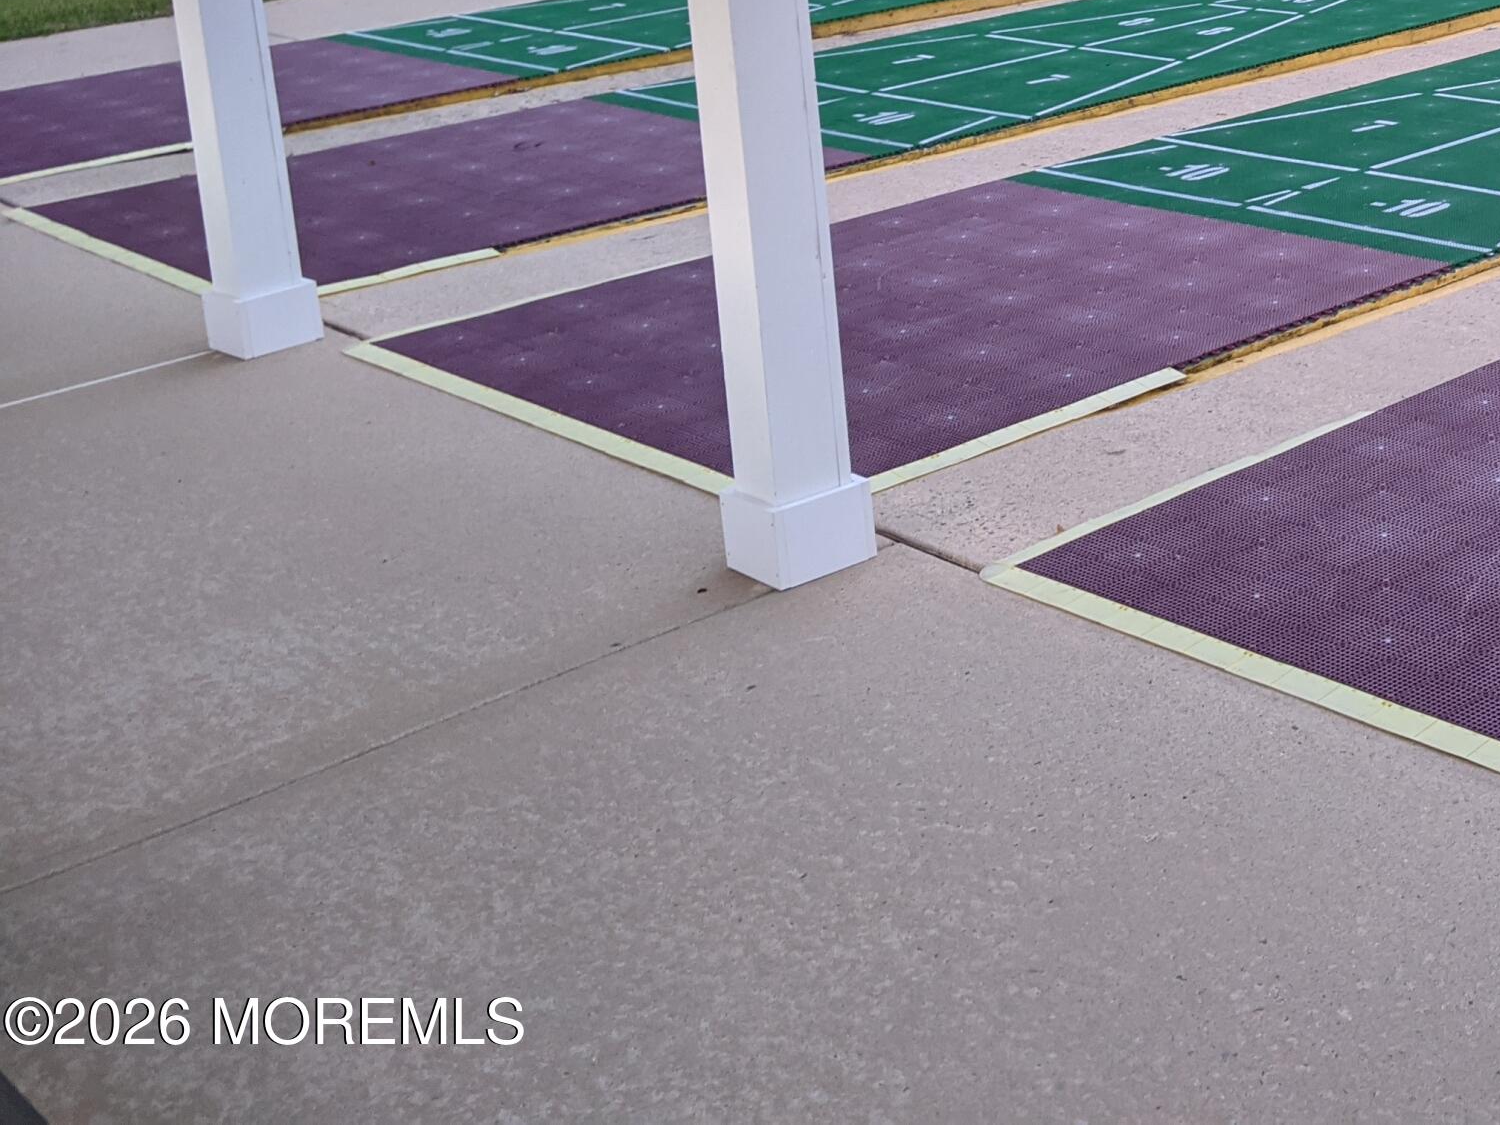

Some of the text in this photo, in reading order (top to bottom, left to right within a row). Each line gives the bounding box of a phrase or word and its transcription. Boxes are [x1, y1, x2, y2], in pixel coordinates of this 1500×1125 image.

[1118, 17, 1155, 27] 8
[1197, 26, 1234, 36] 8
[1352, 120, 1398, 133] 7
[1158, 163, 1231, 181] -10
[1371, 197, 1451, 218] -10
